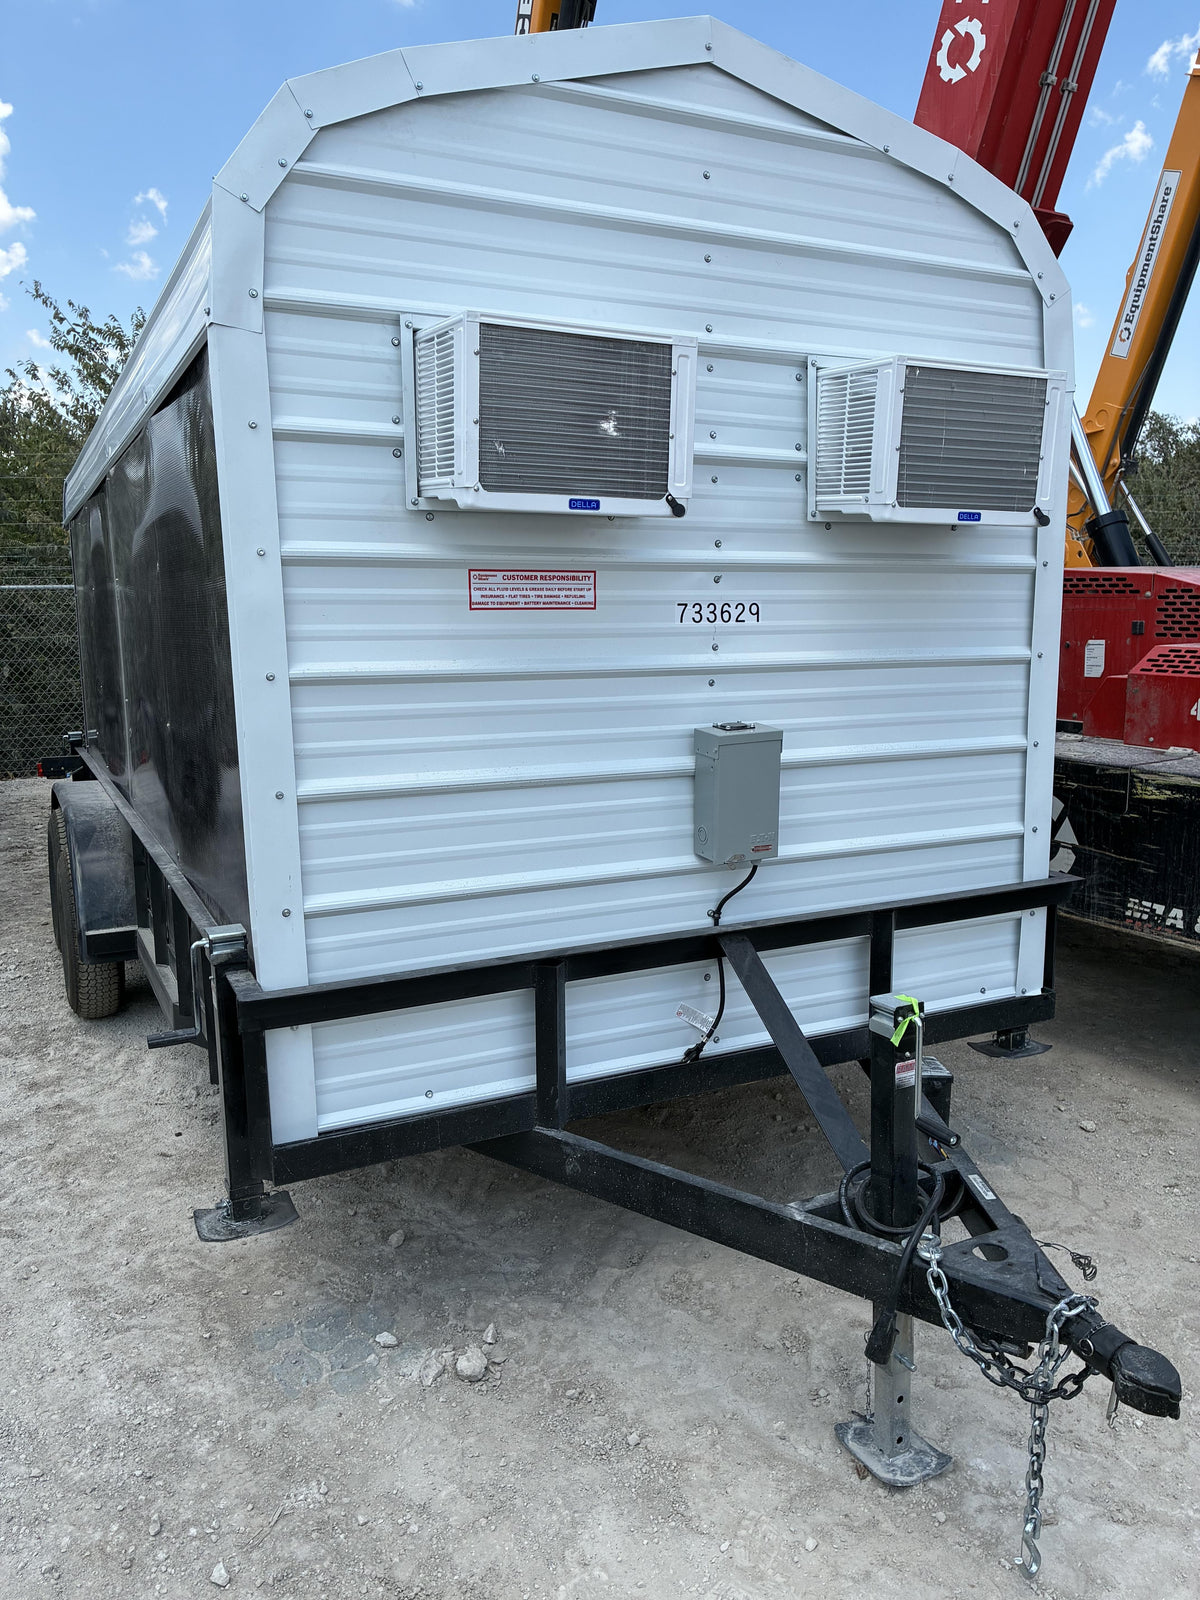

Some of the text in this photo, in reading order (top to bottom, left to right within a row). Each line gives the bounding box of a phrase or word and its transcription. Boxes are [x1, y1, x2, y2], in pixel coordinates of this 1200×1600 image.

[1124, 185, 1172, 325] EquipmentShare
[571, 501, 597, 509] DELLA
[677, 602, 760, 624] 733629
